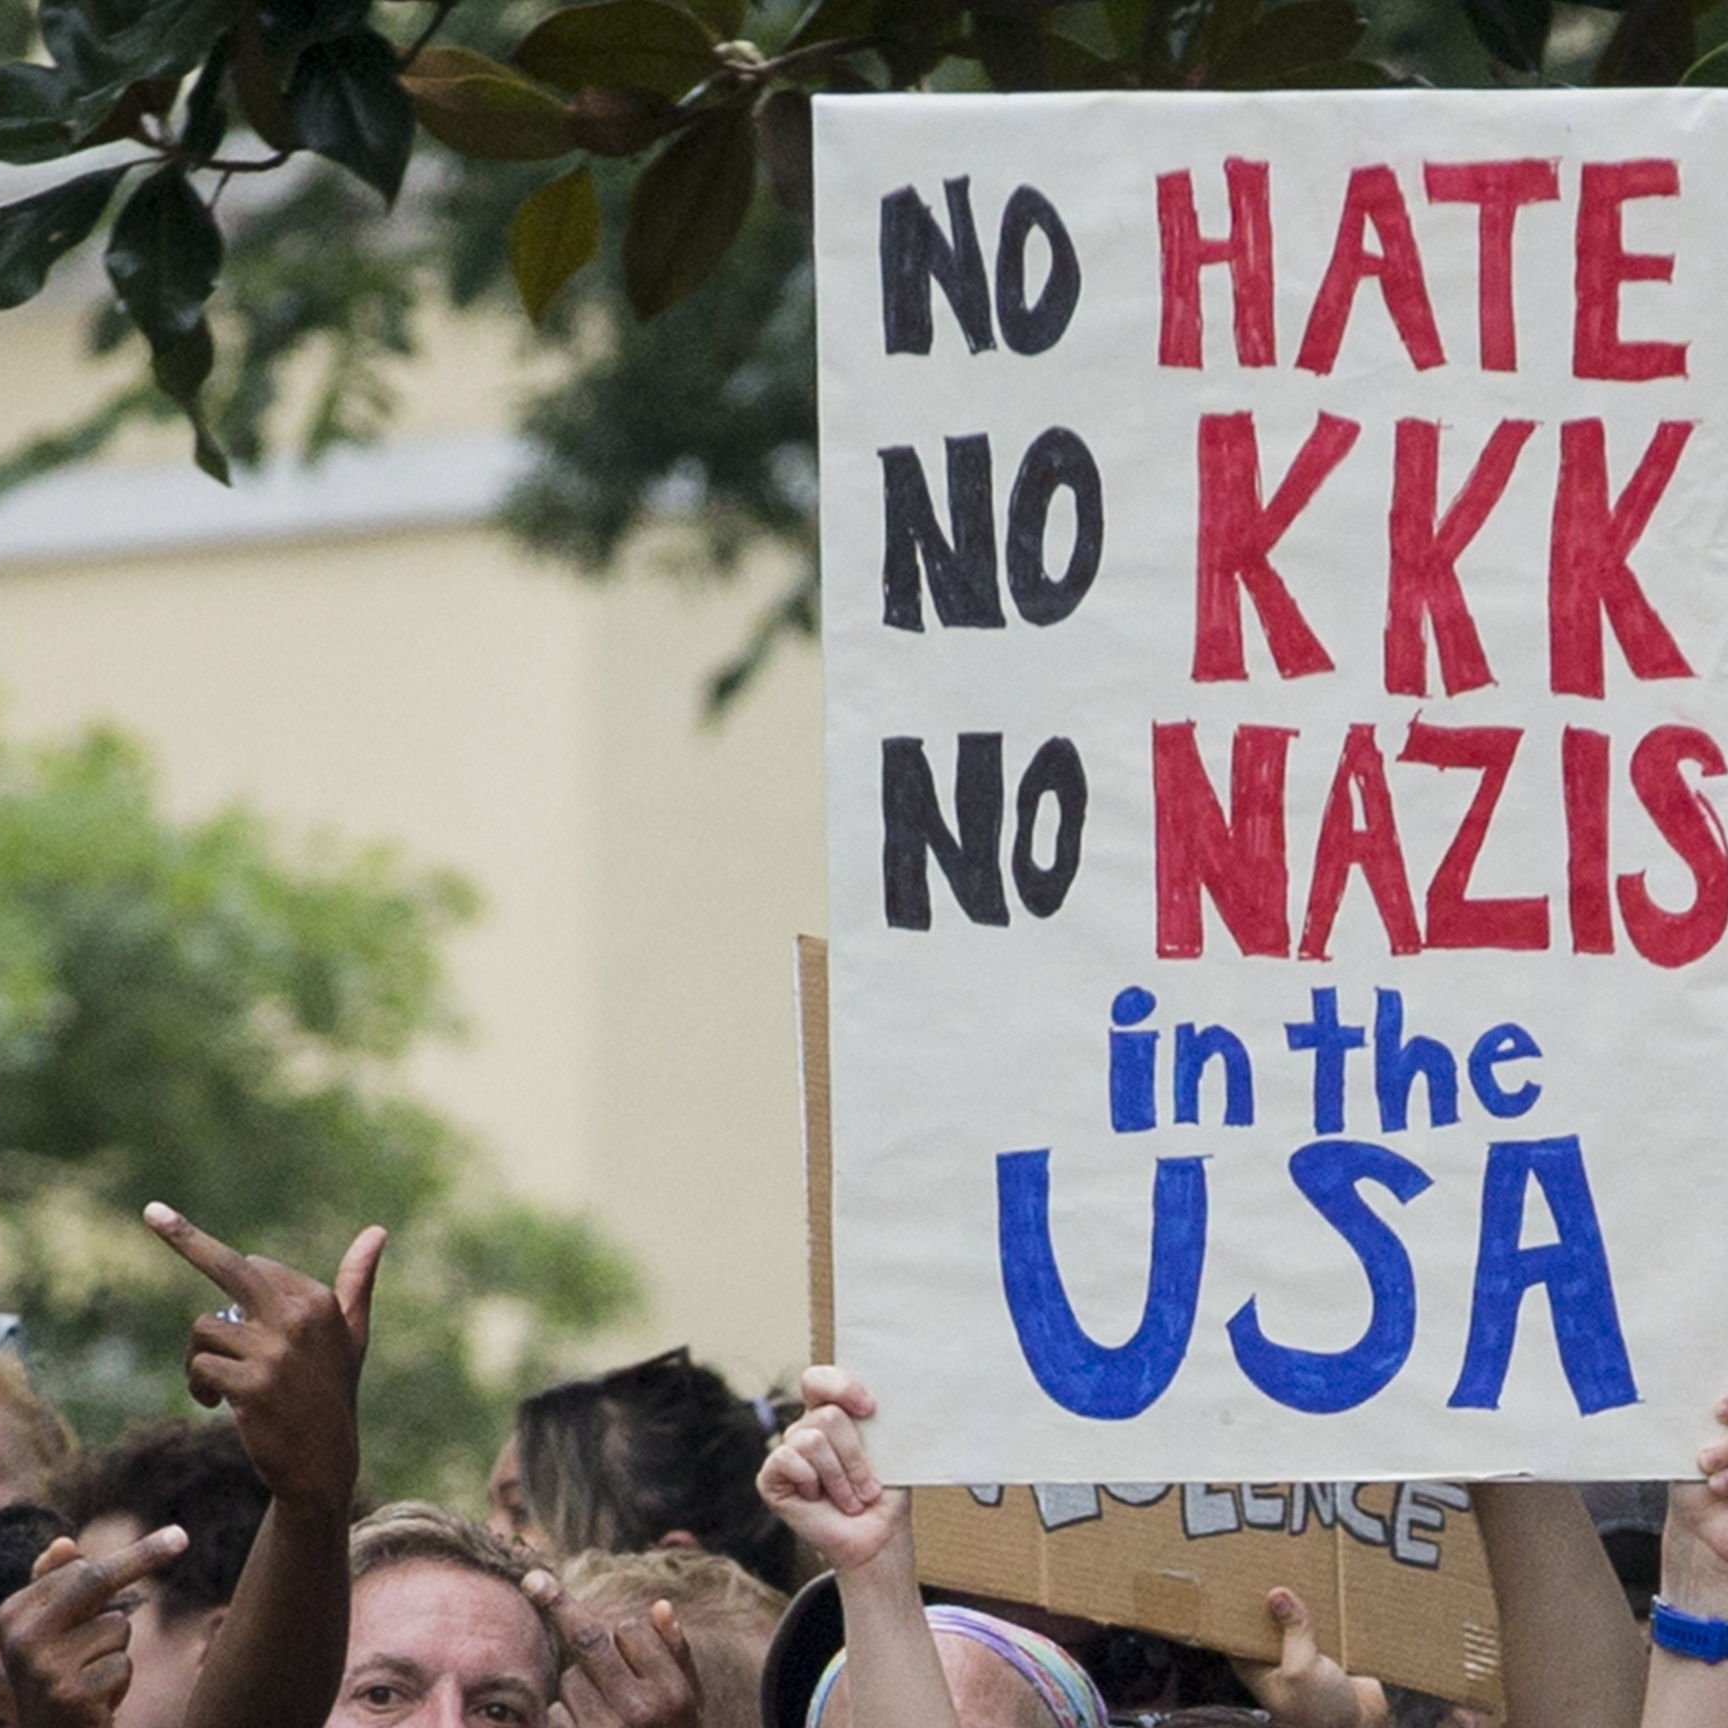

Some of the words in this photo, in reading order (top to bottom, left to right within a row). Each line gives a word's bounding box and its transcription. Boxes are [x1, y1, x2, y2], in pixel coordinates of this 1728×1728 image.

[877, 173, 1083, 357] NO
[1156, 155, 1690, 380] HATE
[877, 425, 1105, 632] NO
[1190, 411, 1700, 700] KKK
[880, 730, 1088, 931] NO
[1107, 984, 1256, 1132] in
[1284, 984, 1544, 1134] the
[995, 1134, 1642, 1421] USA
[968, 1482, 1471, 1569] ILENCE
